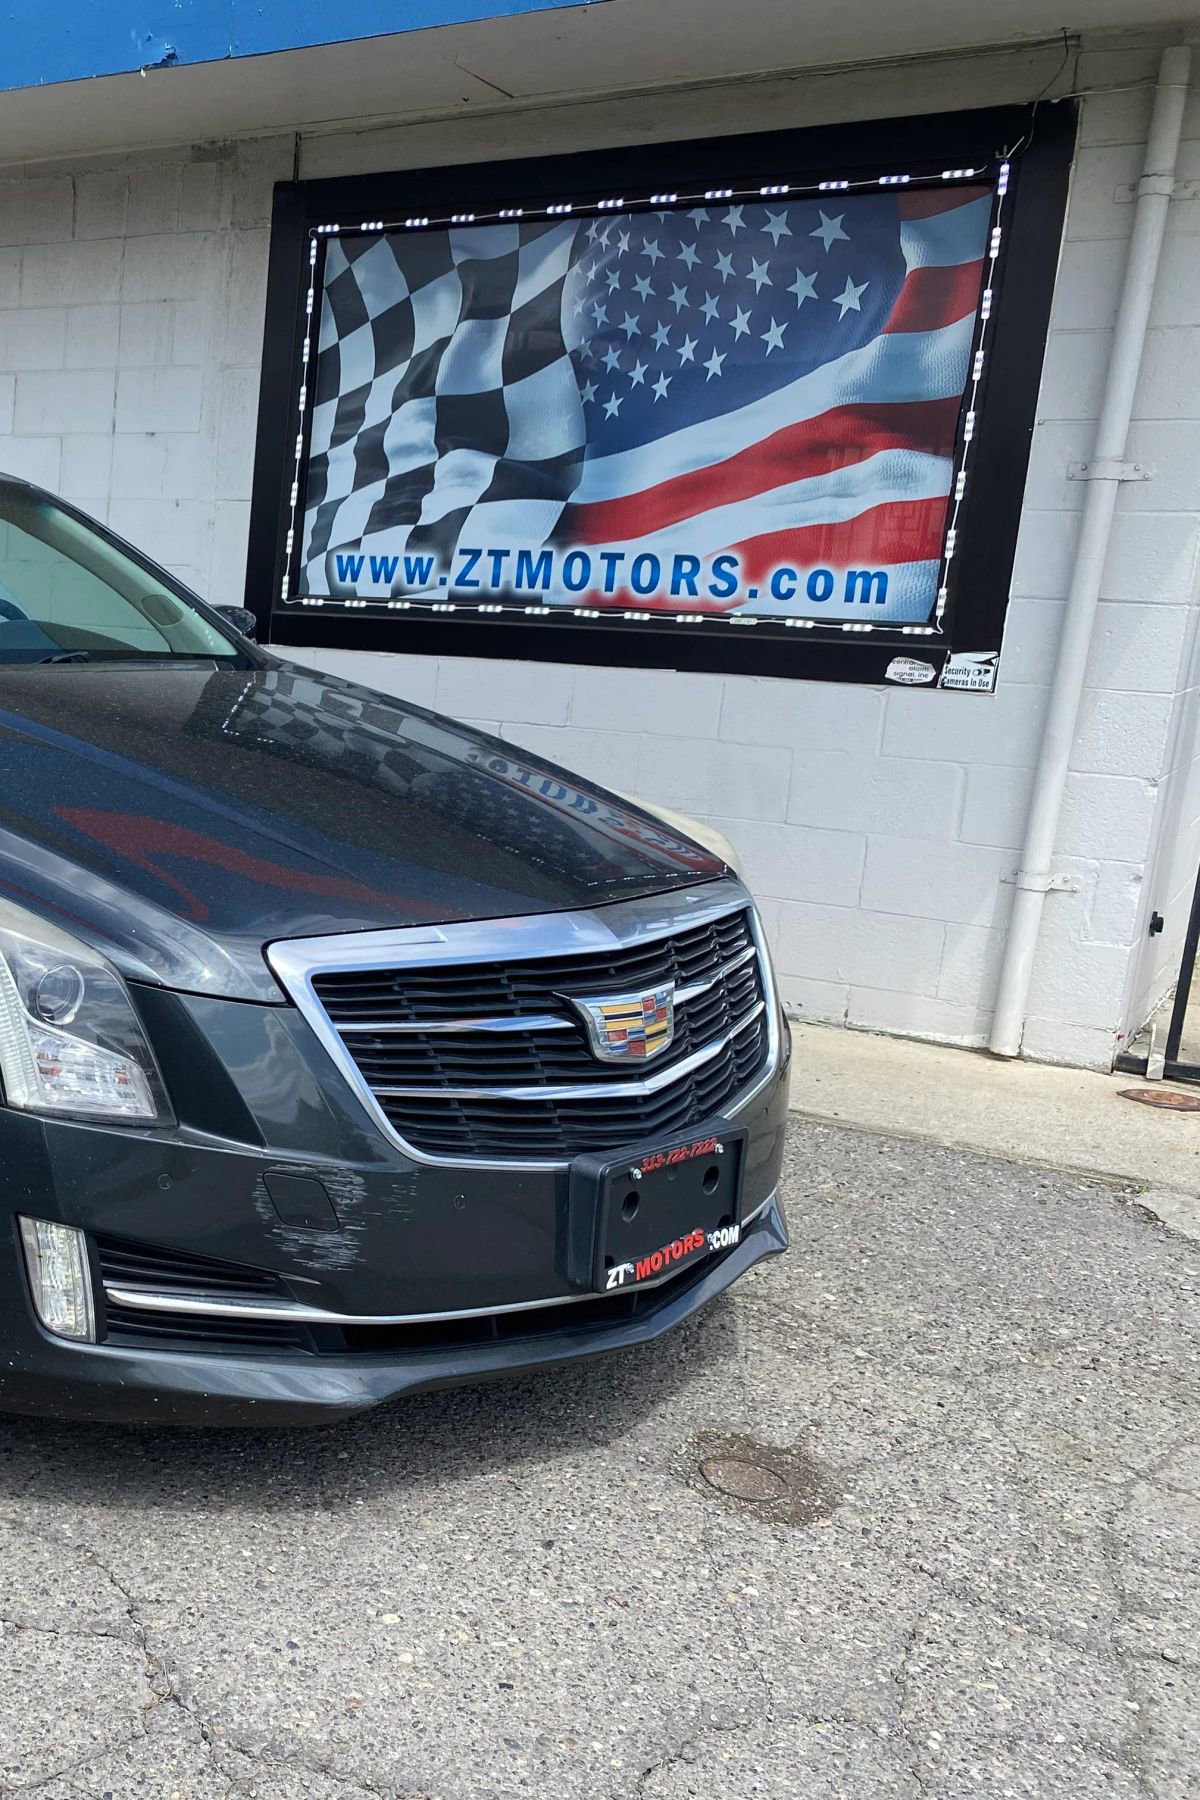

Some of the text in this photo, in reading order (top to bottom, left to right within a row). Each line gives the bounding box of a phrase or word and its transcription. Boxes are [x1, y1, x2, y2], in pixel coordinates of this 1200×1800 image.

[336, 548, 889, 604] www.ZTMOTORS.com
[944, 665, 971, 678] Security
[971, 678, 977, 687] In
[978, 679, 990, 688] Use
[635, 1228, 705, 1281] MOTORS
